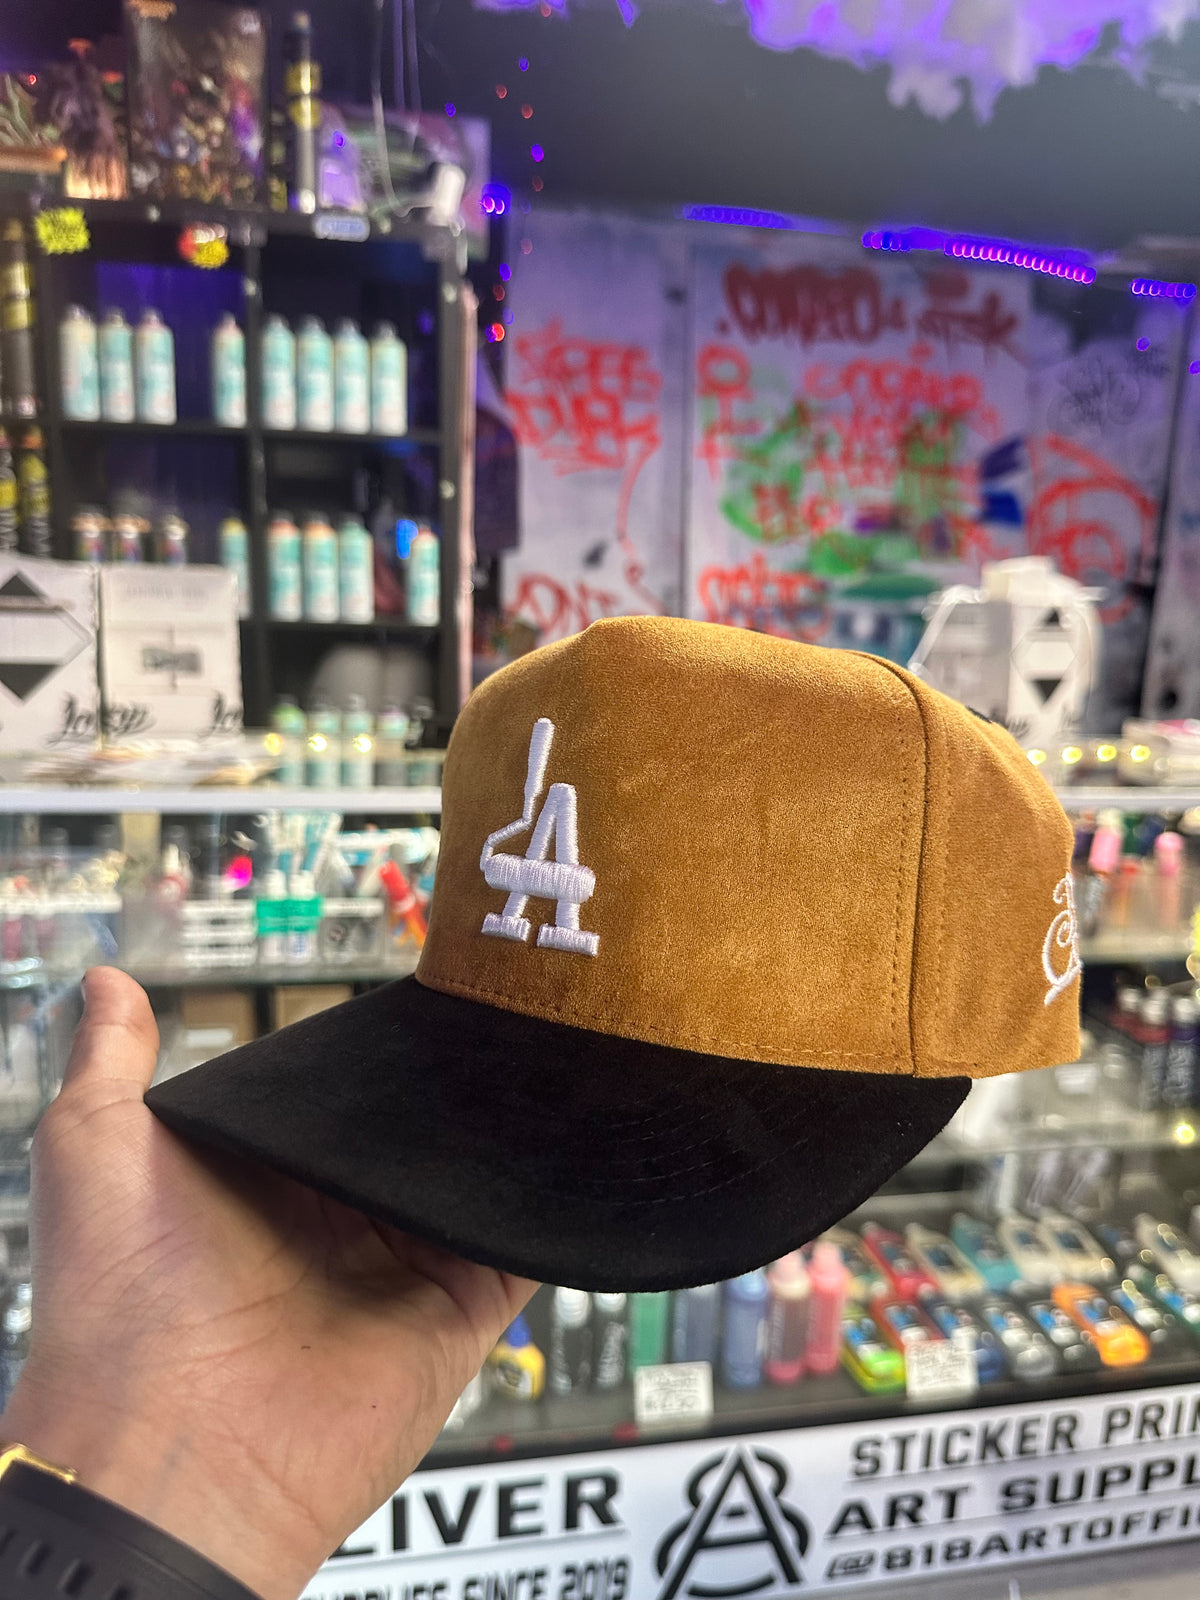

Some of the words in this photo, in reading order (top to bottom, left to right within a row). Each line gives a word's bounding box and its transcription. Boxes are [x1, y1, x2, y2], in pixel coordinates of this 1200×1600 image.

[853, 1413, 1079, 1478] STICKER
[826, 1483, 970, 1537] ART
[827, 1504, 1200, 1580] @818ARTOFFI
